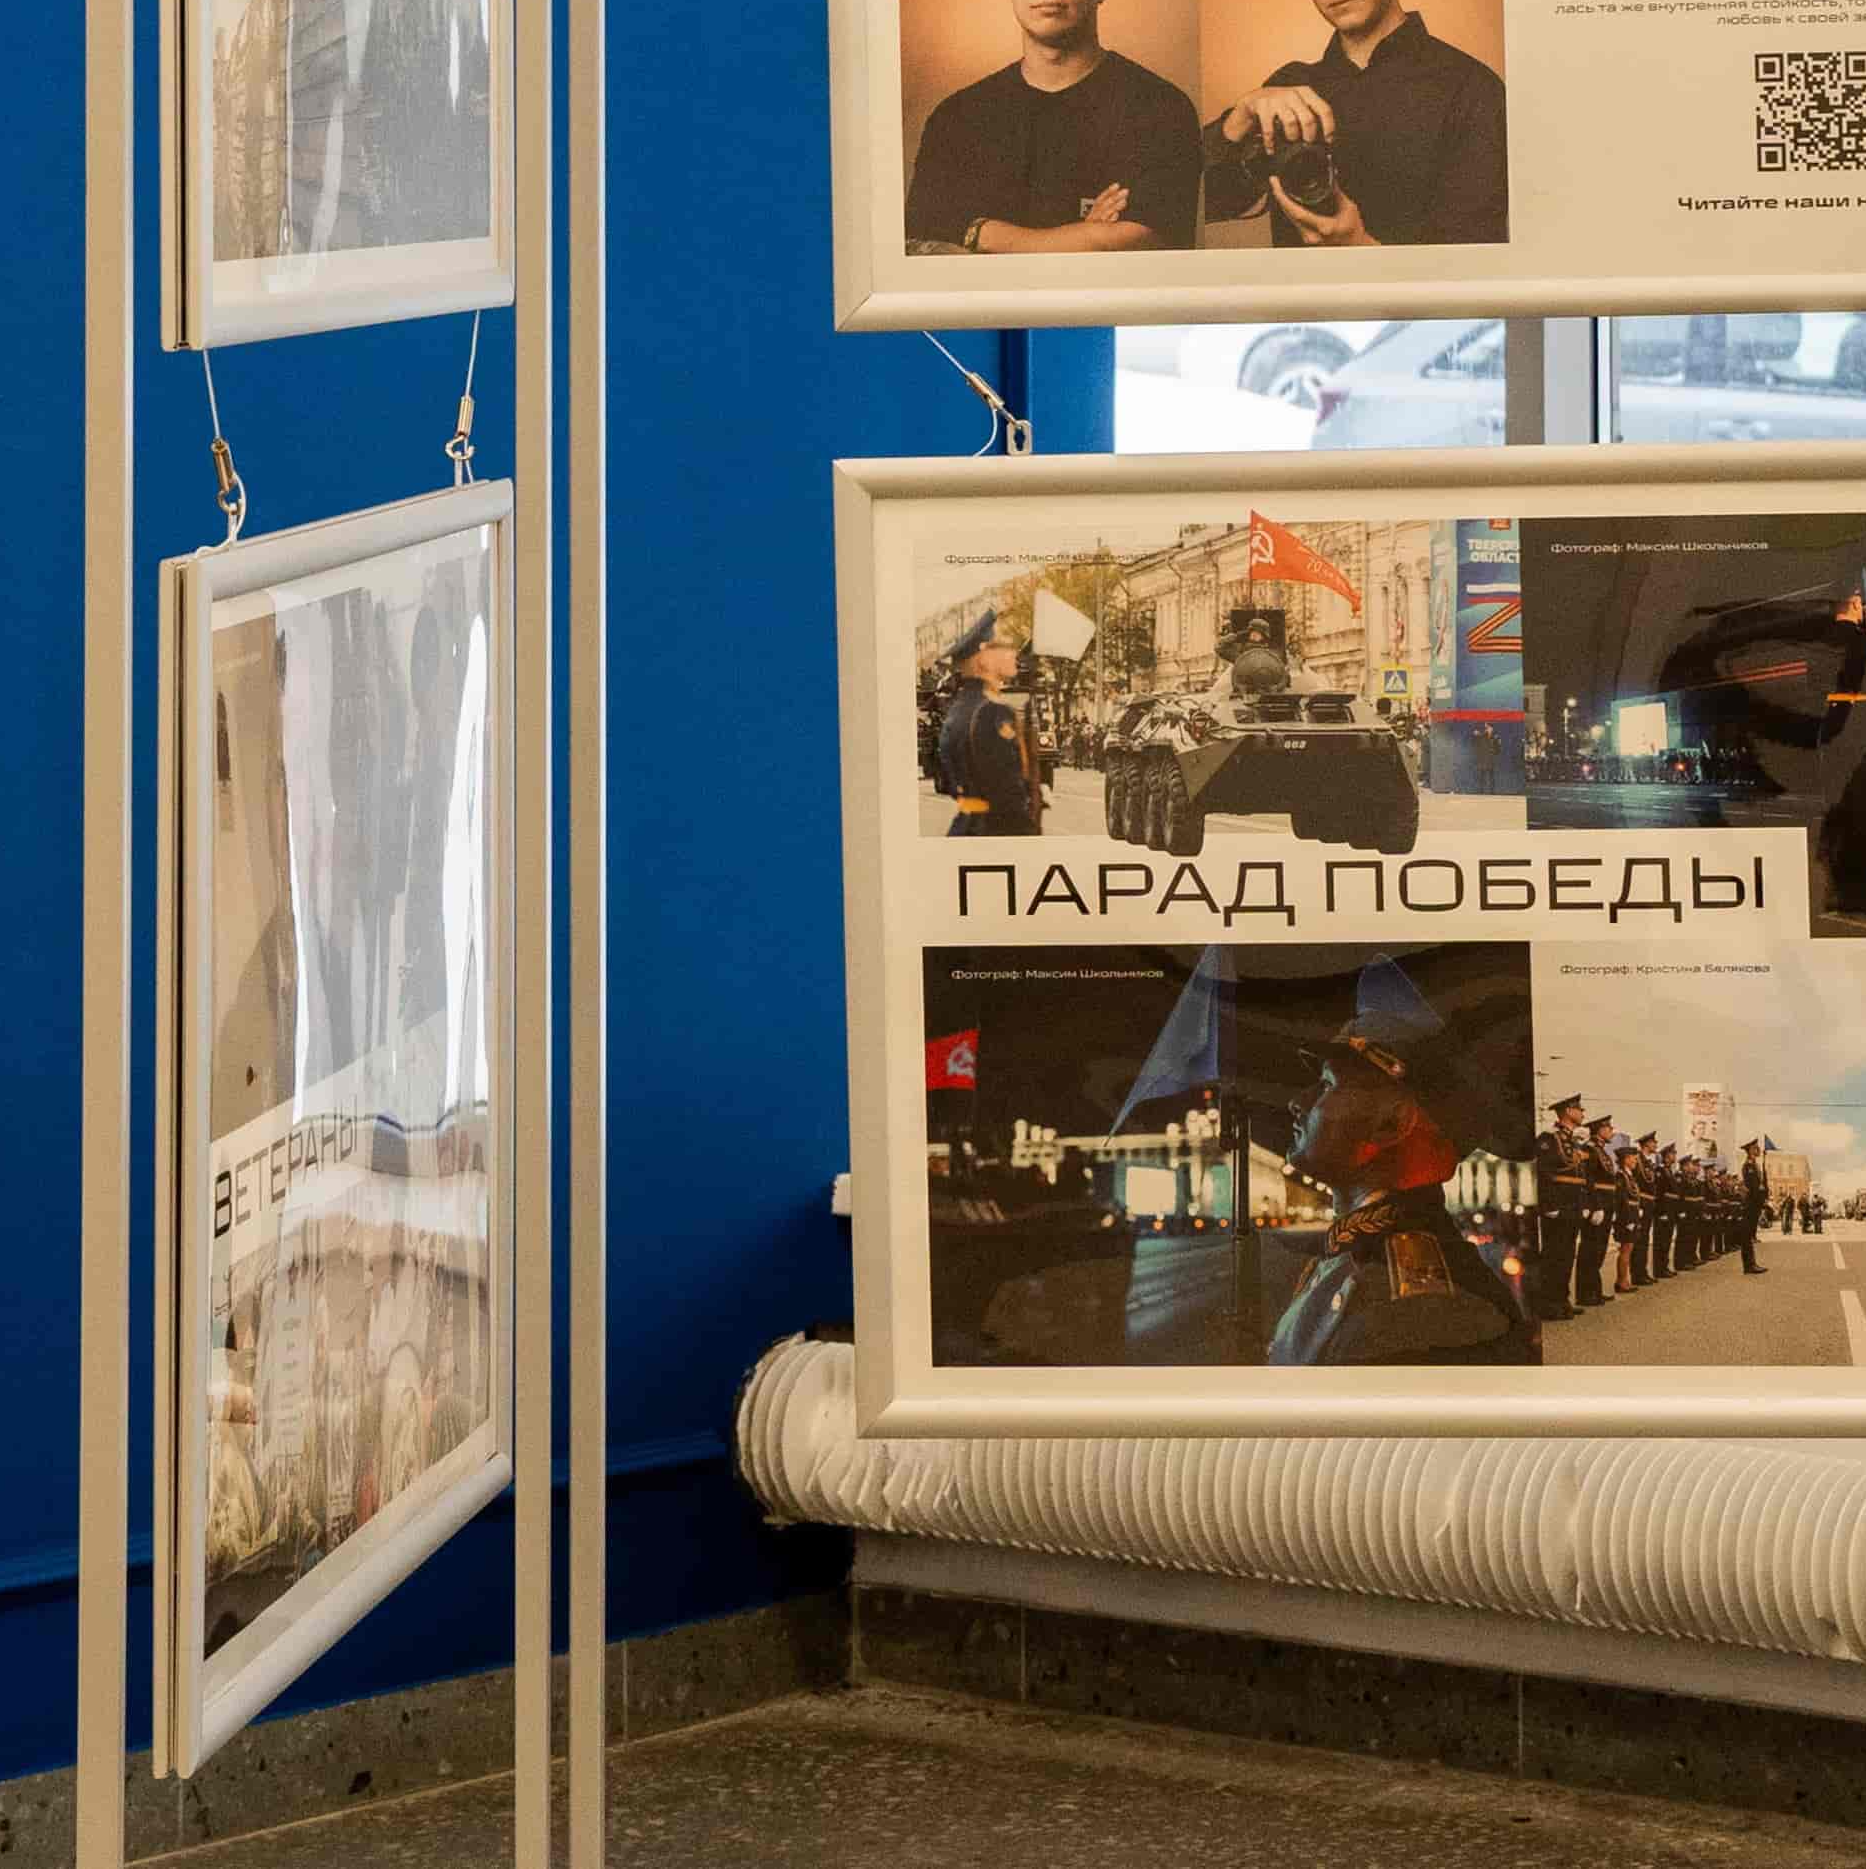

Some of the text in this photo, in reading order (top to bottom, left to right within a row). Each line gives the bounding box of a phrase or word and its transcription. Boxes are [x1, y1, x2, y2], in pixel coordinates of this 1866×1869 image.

[1717, 15, 1781, 25] любовь
[1785, 15, 1793, 23] к
[1798, 12, 1848, 23] своей
[1678, 195, 1778, 210] Читайте
[1785, 197, 1849, 208] наши
[1550, 540, 1768, 554] Фотограф: Максим Школьников
[944, 554, 1013, 565] Фотограф:
[957, 856, 1766, 928] ПАРАД ПОБЕДЫ
[951, 969, 1163, 979] Фотограф: Максим Школьников
[1559, 963, 1770, 975] Фотограф: Кристина Белякова
[214, 1094, 358, 1239] ВЕТЕРАНЫ
